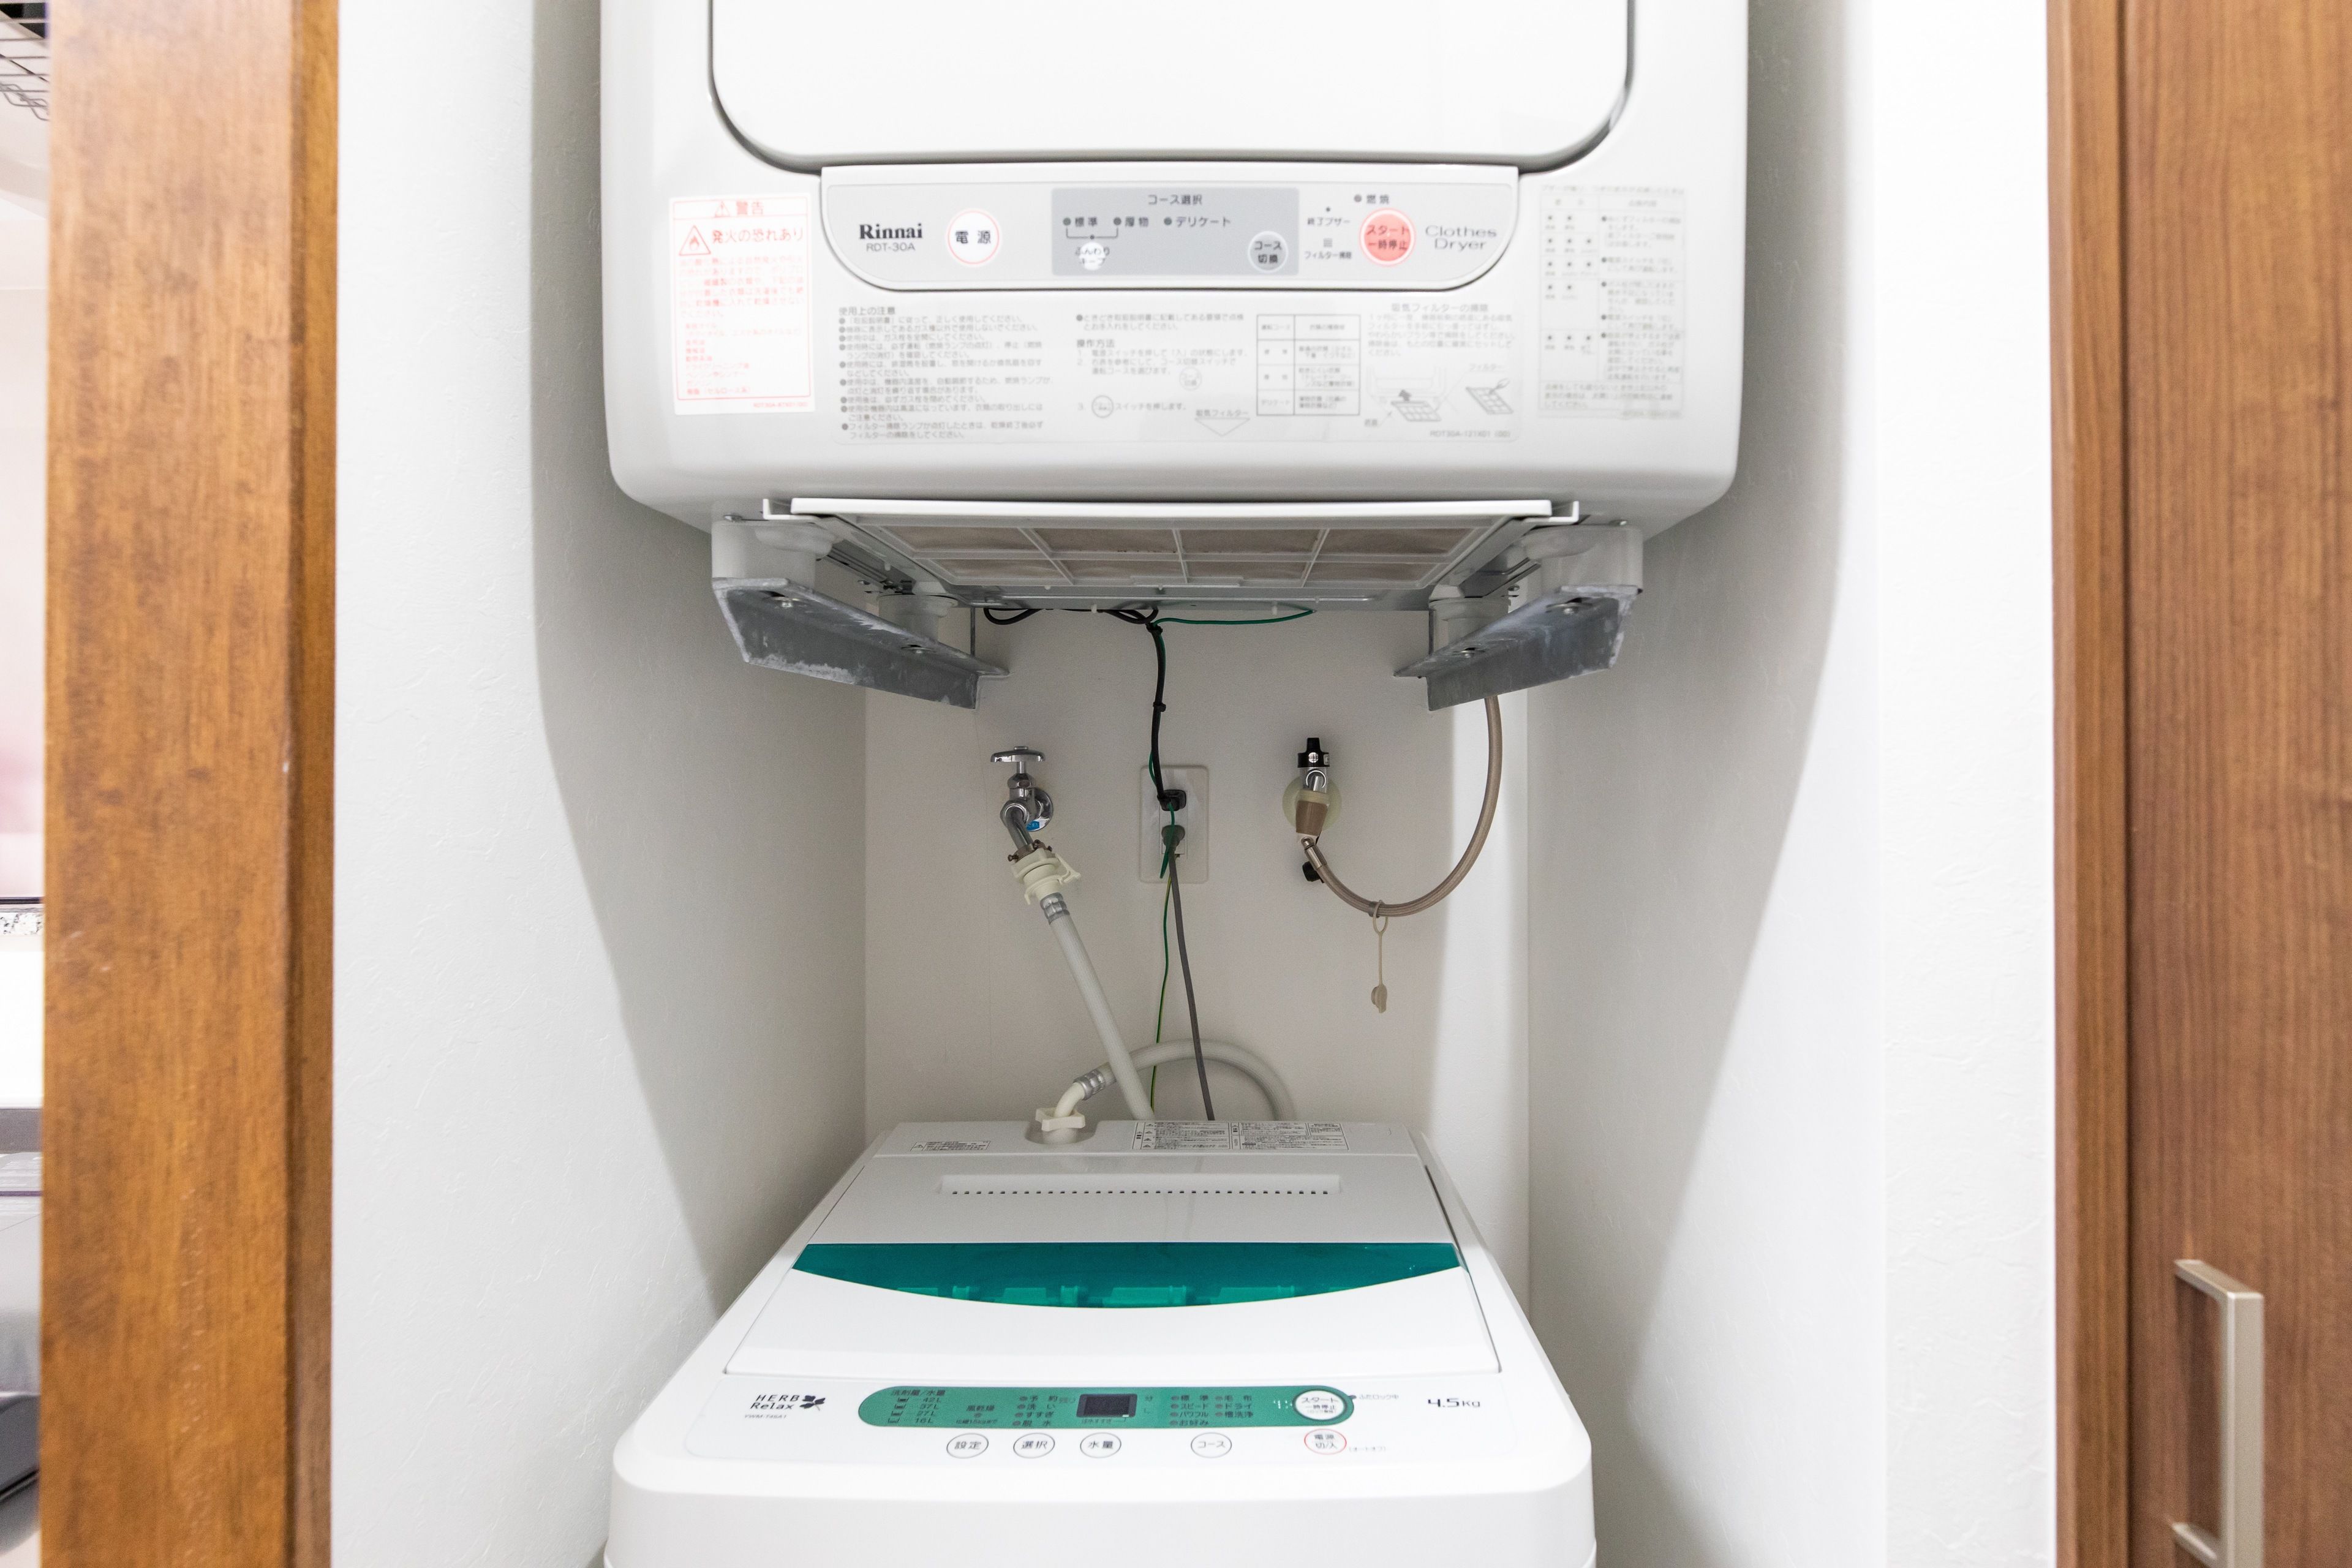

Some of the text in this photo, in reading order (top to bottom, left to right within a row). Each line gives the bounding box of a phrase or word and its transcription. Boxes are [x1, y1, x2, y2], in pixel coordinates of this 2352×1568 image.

[1148, 194, 1202, 205] コース選択
[736, 201, 764, 216] 警告
[1075, 217, 1098, 227] 標準
[1125, 217, 1149, 228] 厚物
[1176, 217, 1231, 228] デリケート
[712, 227, 804, 244] 発火の恐れあり
[859, 223, 922, 239] Rinnai
[1366, 225, 1409, 235] スタート
[1425, 225, 1497, 237] Clothes
[956, 230, 992, 244] 電源
[867, 242, 915, 252] RDT-30A
[1254, 241, 1282, 251] コース
[1368, 239, 1408, 250] 一時停止
[1434, 238, 1487, 251] Dryer
[839, 306, 896, 316] 使用上の注意
[954, 1441, 982, 1450] 設定
[1021, 1441, 1049, 1450] 選択
[1088, 1441, 1114, 1449] 水量
